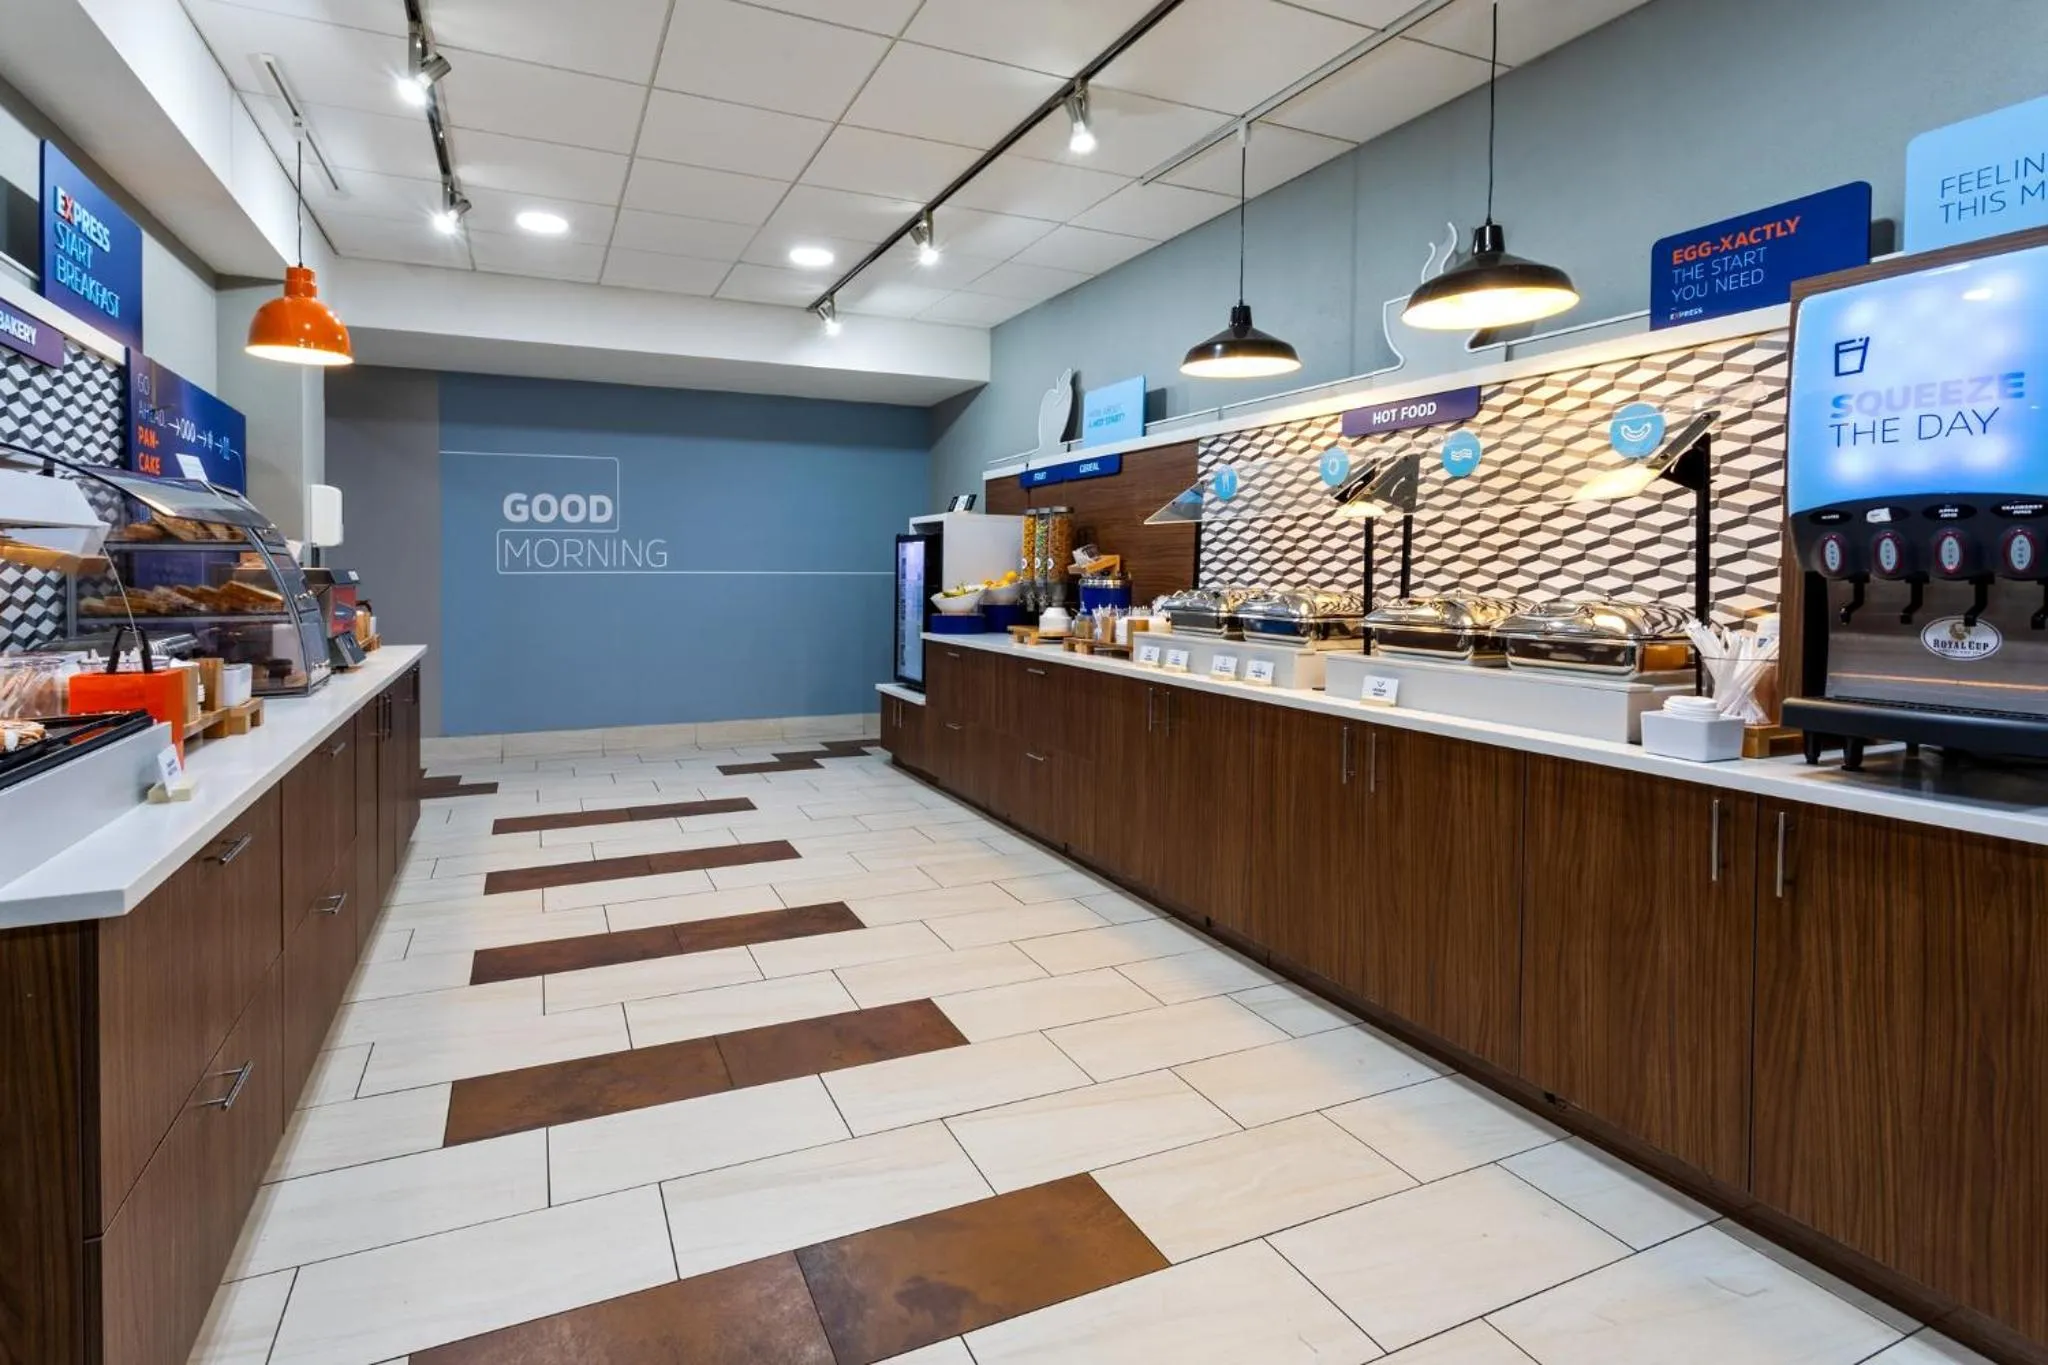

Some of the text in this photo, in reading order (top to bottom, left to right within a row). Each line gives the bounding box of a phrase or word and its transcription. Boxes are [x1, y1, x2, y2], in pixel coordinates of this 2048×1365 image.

[54, 185, 111, 253] EXPRESS
[1940, 190, 2007, 224] THIS
[55, 221, 93, 269] START
[1672, 216, 1801, 265] EGG-XACTLY
[1672, 247, 1767, 285] THE START
[56, 253, 120, 318] BREAKFAST
[1671, 268, 1765, 302] YOU NEED
[1669, 307, 1704, 321] EXPRESS
[137, 373, 150, 396] GO
[1830, 371, 2025, 419] SQUEEZE
[1373, 402, 1437, 424] HOT FOOD
[1829, 407, 1999, 448] THE DAY
[137, 425, 159, 449] PAN-
[138, 452, 161, 476] CAKE
[1080, 462, 1099, 473] CEREAL
[503, 493, 613, 523] GOOD
[504, 538, 667, 568] MORNING
[1933, 638, 1989, 650] ROYAL CUP
